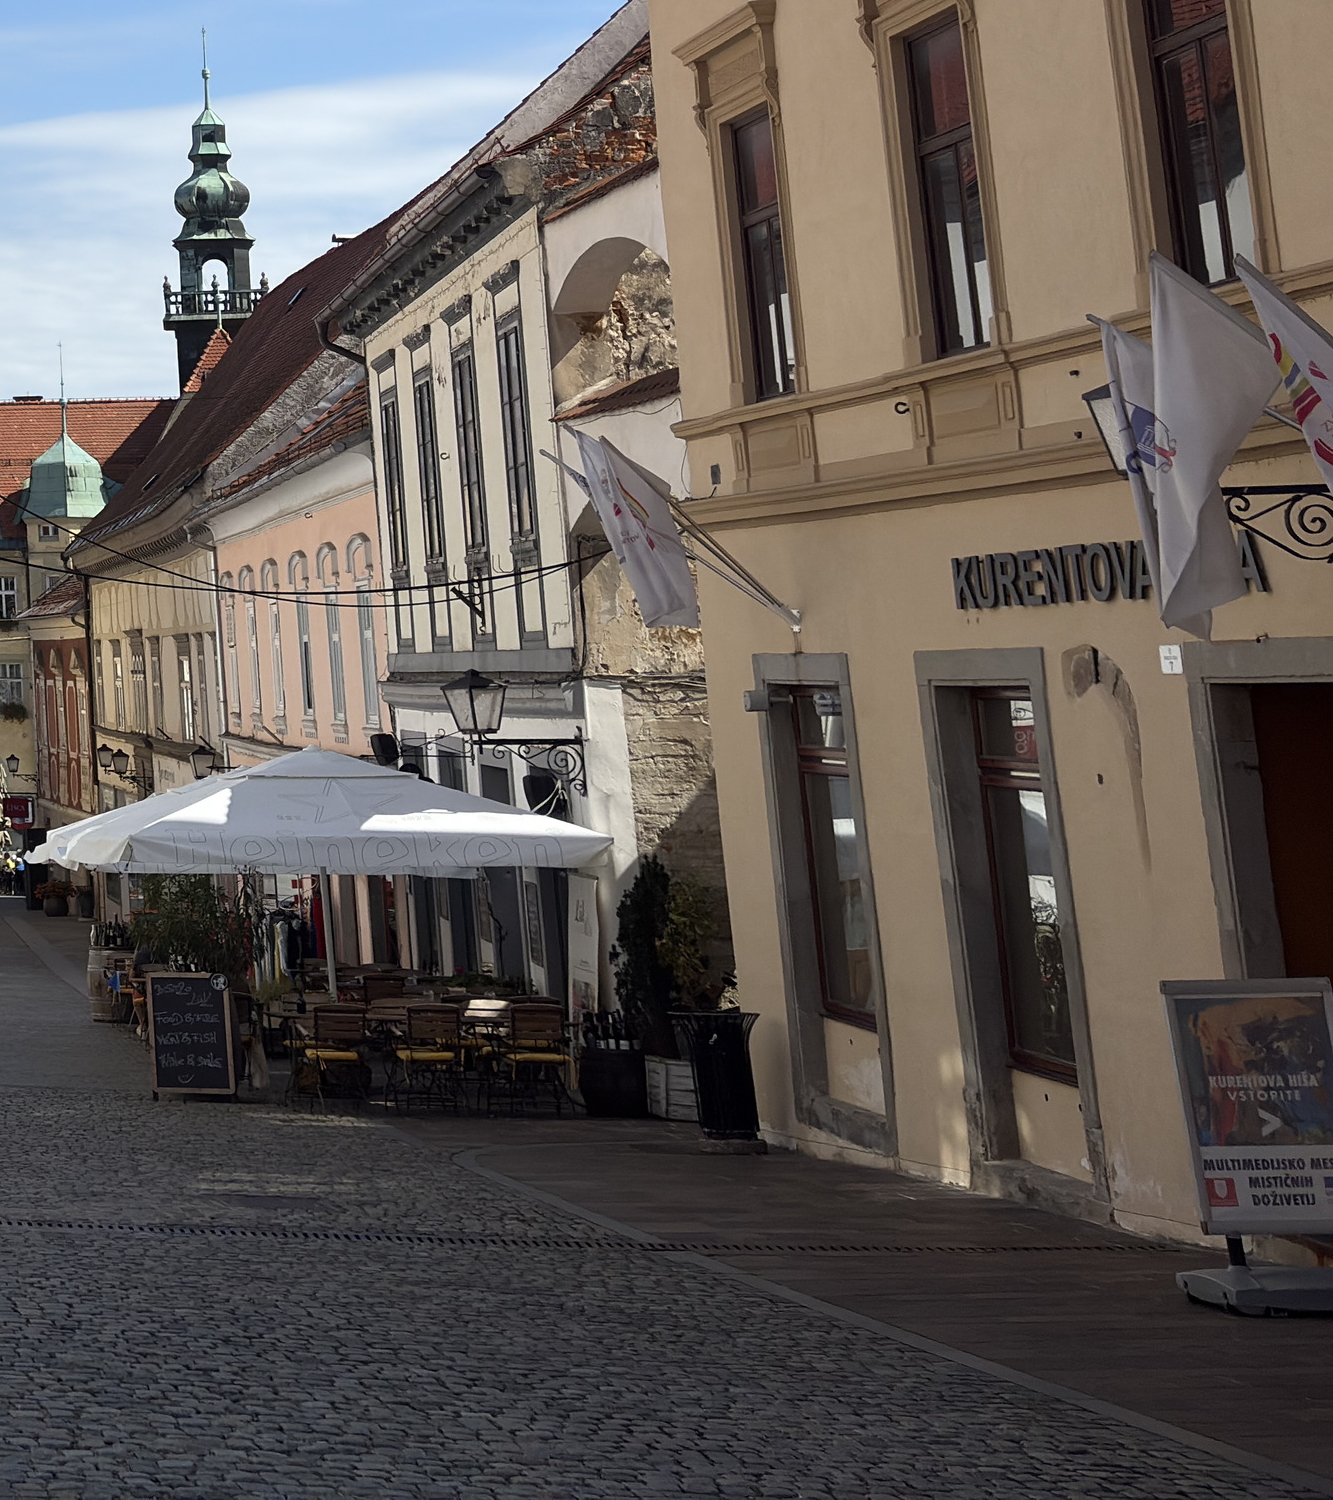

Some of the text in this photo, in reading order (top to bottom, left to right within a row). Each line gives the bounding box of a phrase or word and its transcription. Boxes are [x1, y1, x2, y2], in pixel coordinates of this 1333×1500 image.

[951, 540, 1154, 610] KURENTOVA
[6, 804, 25, 812] LISCA
[164, 827, 564, 869] Heineken
[190, 1031, 217, 1044] FISH
[1209, 1071, 1318, 1088] KURENTOVA HIŠA
[1227, 1090, 1301, 1102] VSTOPITE
[1203, 1158, 1306, 1171] MULTIMEDIJSKO
[1248, 1173, 1313, 1189] MISTIČNIH
[1251, 1190, 1316, 1206] DOŽIVETIJ
